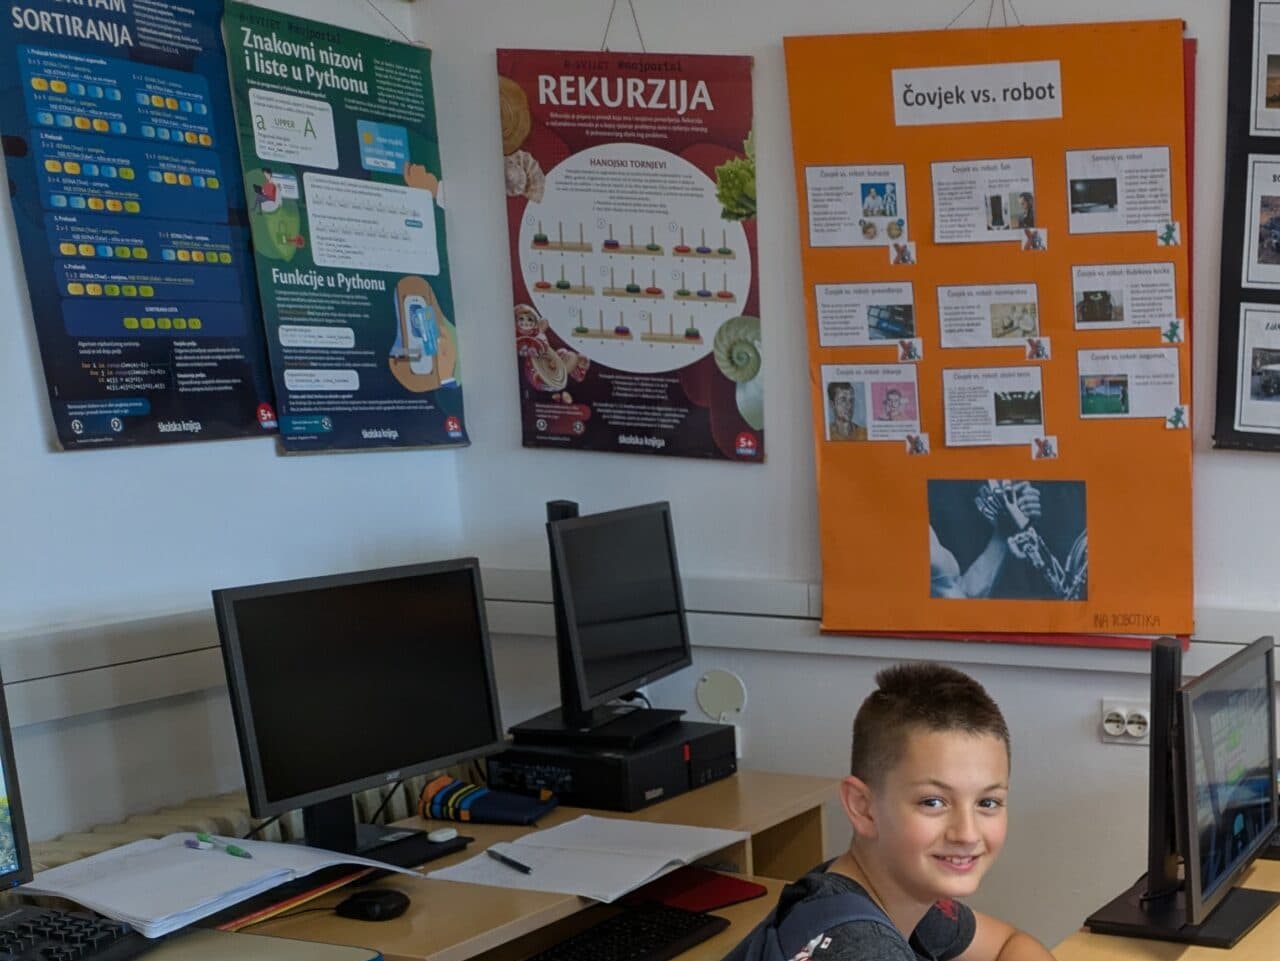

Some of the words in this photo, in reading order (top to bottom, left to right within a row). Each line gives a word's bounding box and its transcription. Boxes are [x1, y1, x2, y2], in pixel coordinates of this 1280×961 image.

[11, 6, 134, 48] SORTIRANJA
[240, 26, 316, 63] Znakovni
[320, 46, 364, 73] nizovi
[244, 50, 252, 71] i
[254, 51, 288, 78] liste
[291, 67, 302, 81] u
[305, 64, 369, 95] Pythonu
[538, 74, 714, 115] REKURZIJA
[902, 84, 966, 110] Čovjek
[971, 88, 996, 104] vs.
[1002, 82, 1056, 102] robot
[590, 159, 628, 169] HANOJSKI
[629, 160, 667, 170] TORNJEVI
[271, 268, 324, 291] Funkcije
[326, 276, 336, 287] u
[337, 273, 386, 292] Pythonu
